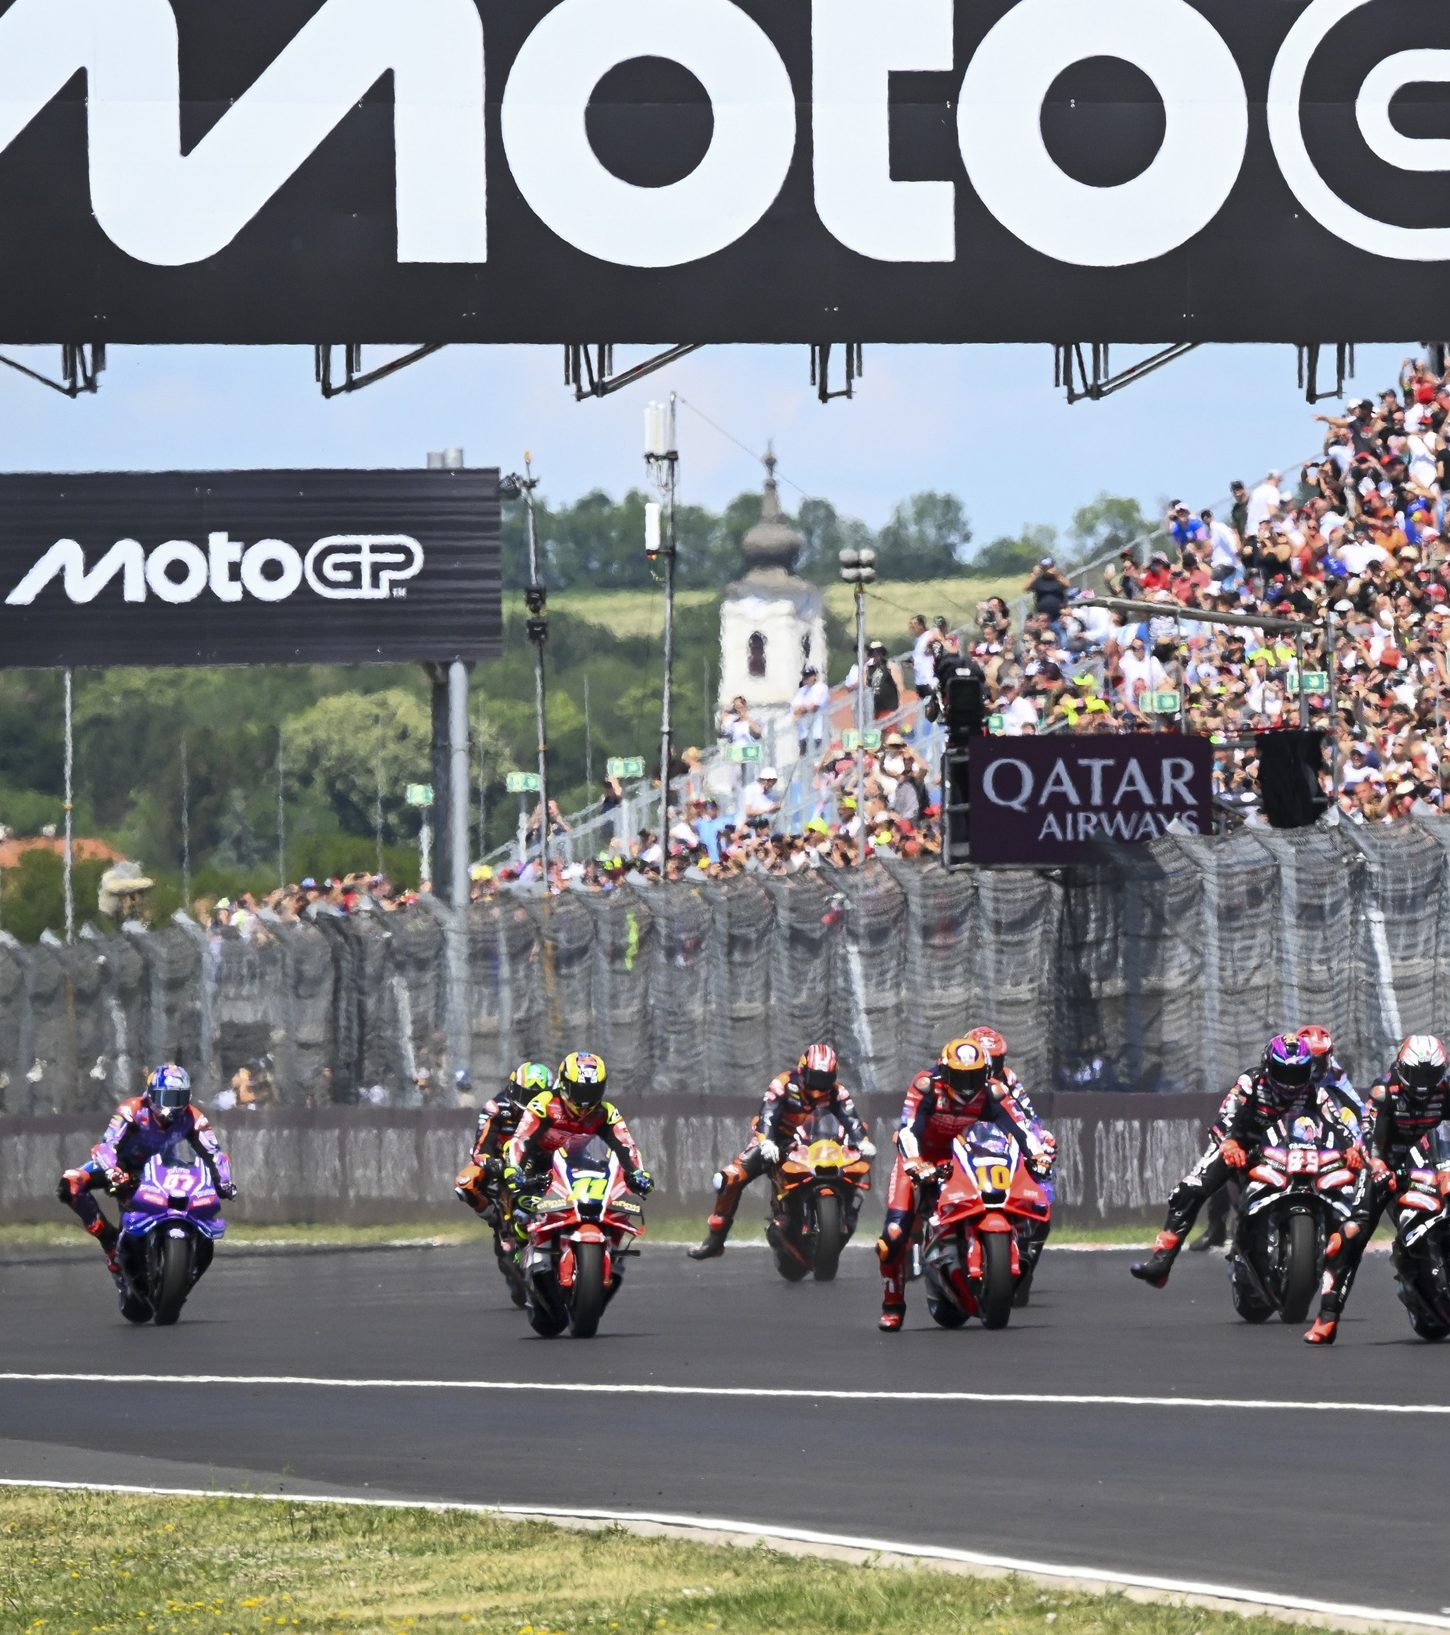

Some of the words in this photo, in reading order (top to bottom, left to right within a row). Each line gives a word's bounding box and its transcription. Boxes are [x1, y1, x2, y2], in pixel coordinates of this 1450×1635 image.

[981, 757, 1199, 813] QATAR
[569, 1177, 609, 1201] 11
[976, 1165, 1011, 1191] 10
